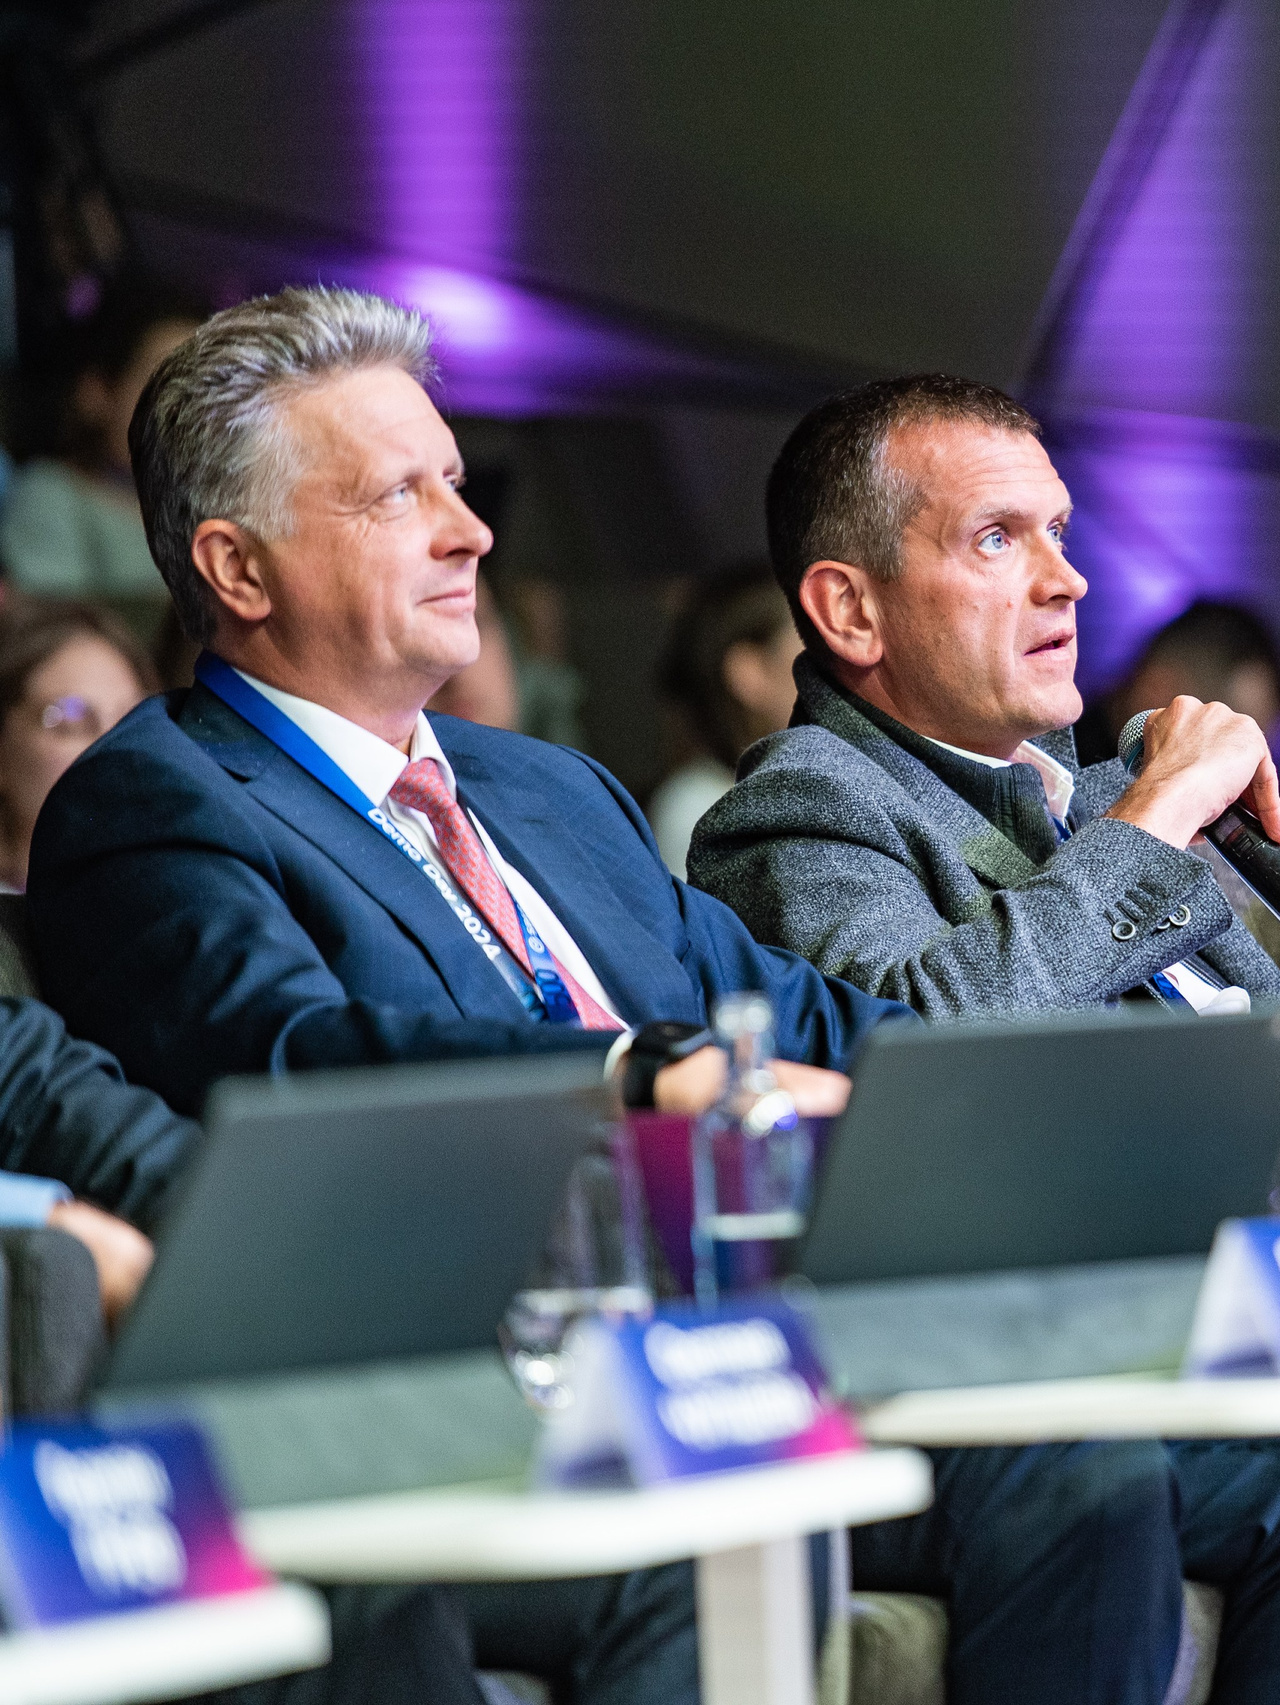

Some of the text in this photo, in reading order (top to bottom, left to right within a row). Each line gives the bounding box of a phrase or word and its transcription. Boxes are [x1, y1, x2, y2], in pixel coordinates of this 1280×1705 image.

[367, 807, 502, 961] Demo Day 2024
